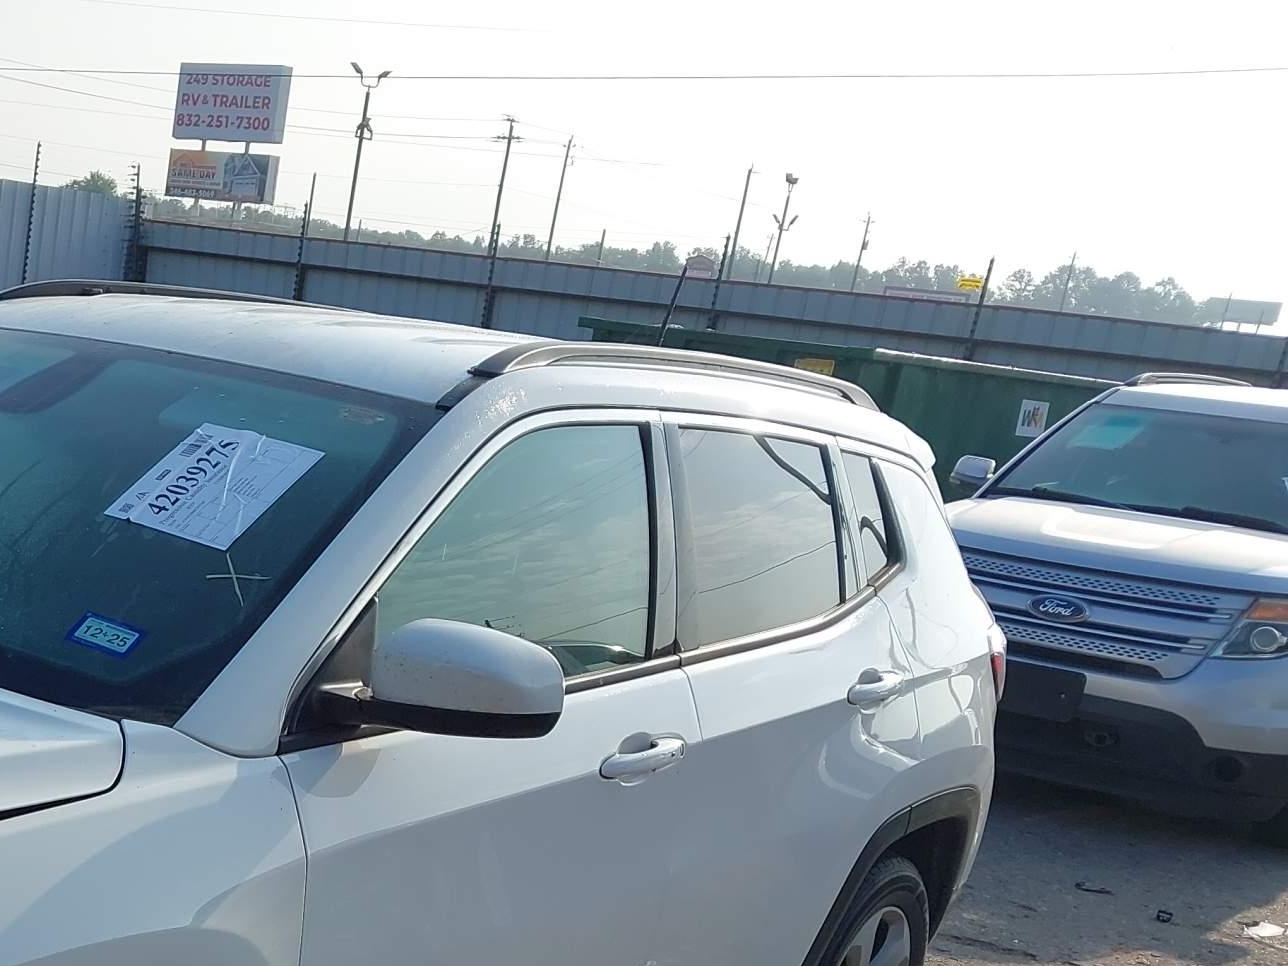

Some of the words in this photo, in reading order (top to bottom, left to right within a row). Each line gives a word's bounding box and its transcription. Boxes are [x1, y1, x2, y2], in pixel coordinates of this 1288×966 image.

[185, 74, 208, 86] 249
[211, 74, 272, 88] STORAGE
[181, 93, 201, 106] RV
[212, 94, 272, 110] TRAILER
[176, 113, 270, 131] 832-251-7300
[148, 439, 241, 516] 42039275
[1039, 598, 1076, 616] Ford
